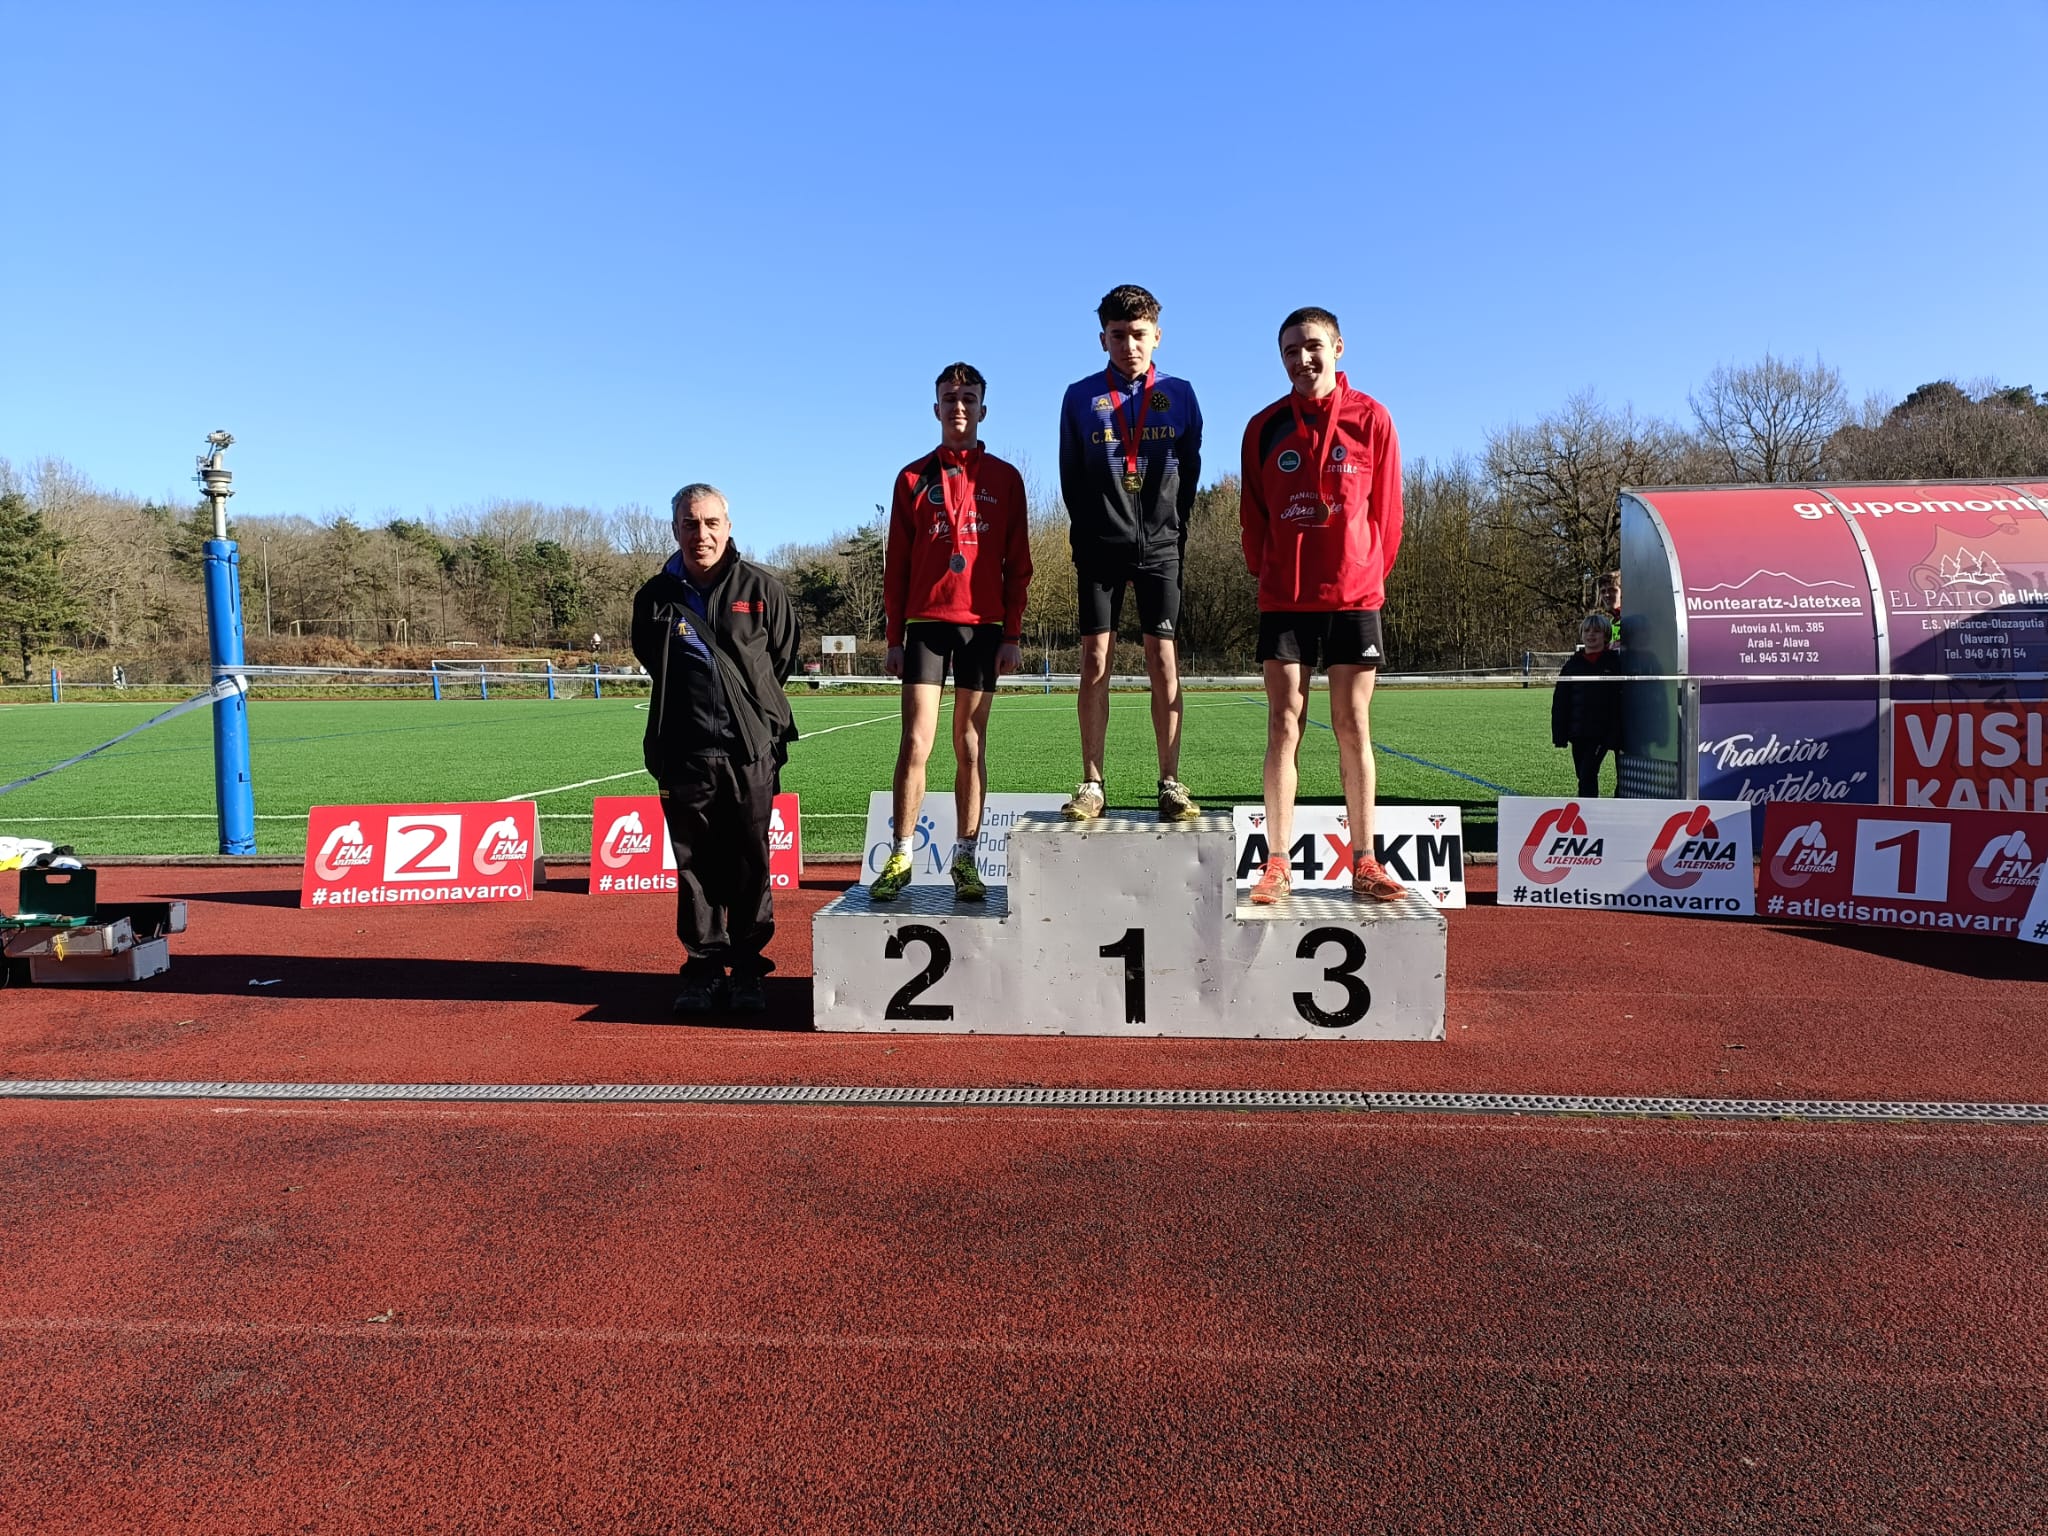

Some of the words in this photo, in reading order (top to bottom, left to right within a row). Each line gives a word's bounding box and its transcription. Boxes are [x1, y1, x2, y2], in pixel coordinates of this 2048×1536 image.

[1688, 595, 1861, 611] Montearatz-Jatetxea
[1888, 590, 1917, 607] EL
[1924, 589, 1994, 607] PATIO
[1998, 589, 2017, 605] de
[1731, 622, 1767, 634] Autovia
[1806, 622, 1825, 633] 385
[1922, 619, 1942, 630] E.S.
[1959, 632, 2009, 645] (Navarra)
[1739, 652, 1757, 664] Tel.
[1759, 652, 1777, 663] 945
[1780, 652, 1790, 663] 31
[1792, 652, 1804, 662] 47
[1806, 652, 1819, 662] 32
[1944, 648, 1962, 660] Tel.
[1964, 648, 1983, 659] 948
[1986, 648, 1999, 659] 46
[2001, 648, 2011, 658] 71
[2013, 647, 2026, 658] 54
[394, 824, 451, 874] 2
[493, 839, 528, 855] FNA
[619, 834, 652, 849] FNA
[1548, 837, 1604, 857] FNA
[336, 844, 373, 860] FNA
[489, 853, 527, 862] ATLETISMO
[1678, 841, 1737, 862] FNA
[1794, 849, 1839, 867] FNA
[332, 857, 371, 867] ATLETISMO
[1543, 856, 1603, 866] ATLETISMO
[1673, 860, 1736, 871] ATLETISMO
[1790, 863, 1837, 874] ATLETISMO
[1875, 829, 1921, 895] 1
[312, 884, 523, 905] #atletismonavarro
[1513, 886, 1741, 911] #atletismonavarro
[1767, 895, 2024, 932] #atletismonavarr
[884, 924, 954, 1021] 2
[1099, 927, 1146, 1024] 1
[1292, 926, 1372, 1028] 3
